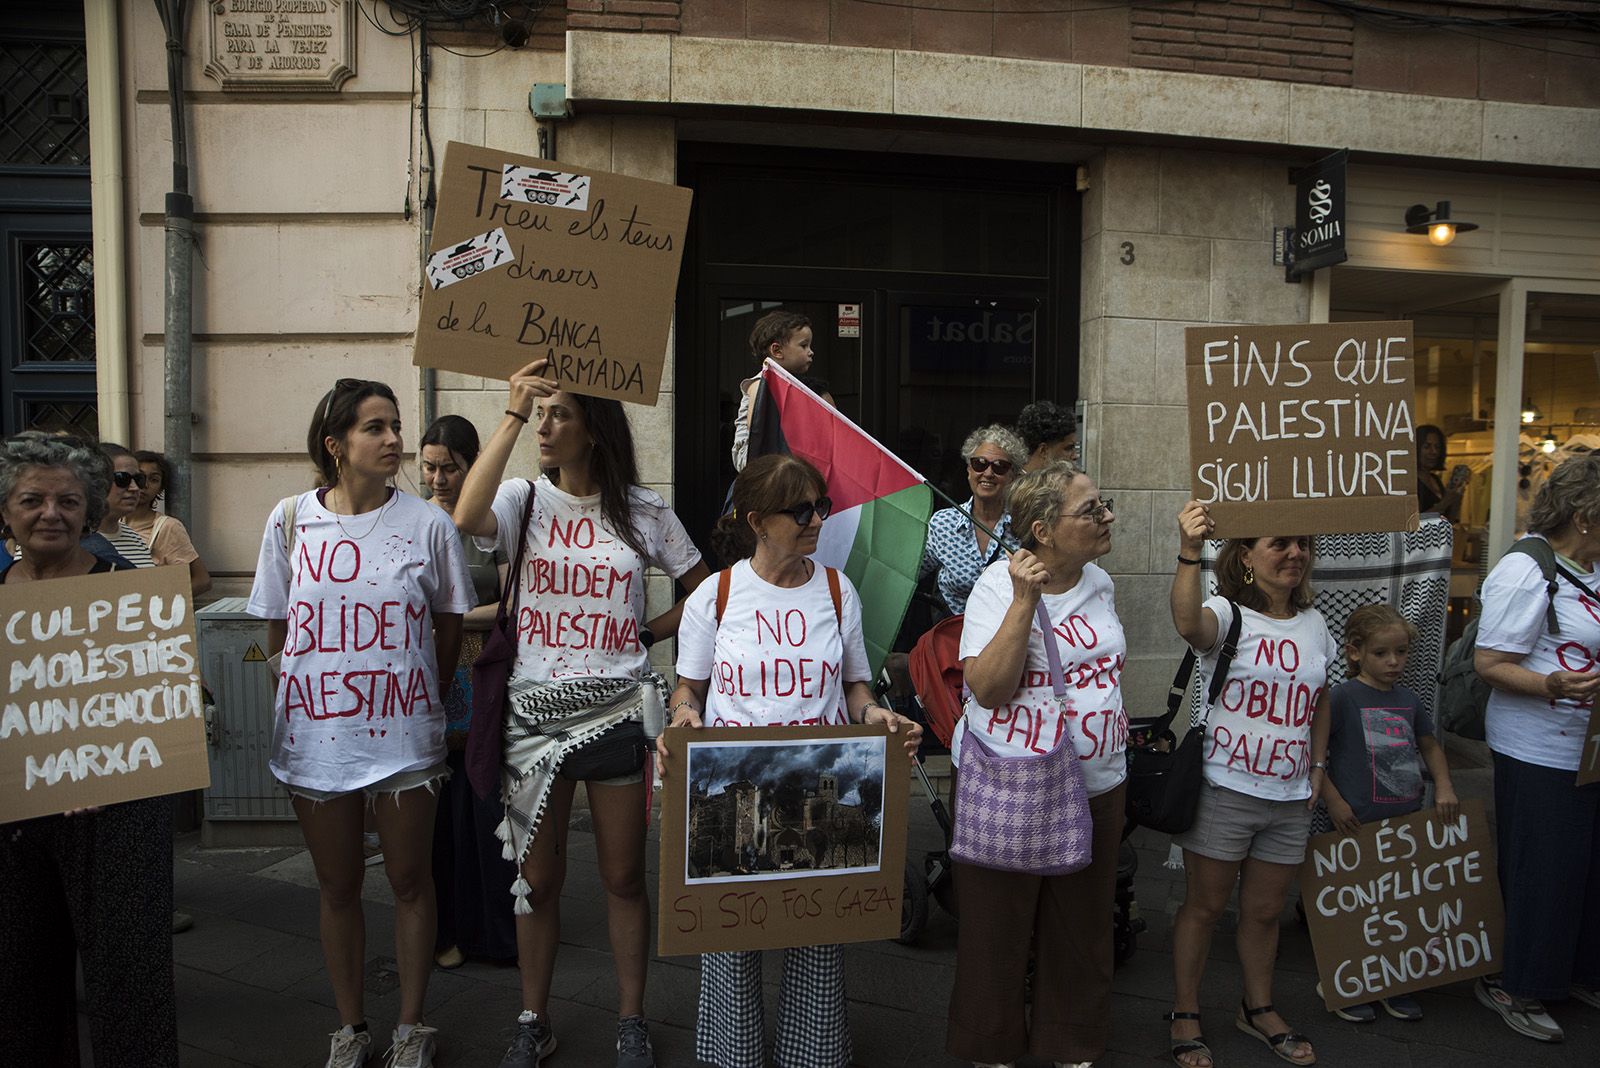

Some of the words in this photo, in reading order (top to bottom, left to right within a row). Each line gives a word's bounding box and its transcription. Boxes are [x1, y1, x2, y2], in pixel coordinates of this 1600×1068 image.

[224, 21, 252, 37] CAJA
[256, 24, 271, 37] DE
[276, 23, 333, 38] PENSIONES
[230, 0, 271, 13] EDIFICIO
[275, 0, 327, 13] PROPIEDAD
[226, 40, 256, 53] PARA
[265, 40, 280, 53] LA
[291, 40, 327, 54] VEJEZ
[233, 56, 241, 69] Y
[248, 56, 263, 70] DE
[269, 56, 320, 70] AHORROS
[467, 164, 552, 232] Treu
[568, 199, 609, 241] els
[620, 205, 673, 251] teus
[507, 245, 599, 290] diners
[1120, 241, 1135, 265] 3
[437, 301, 459, 331] de
[467, 301, 500, 337] la
[516, 302, 602, 355] BANCA
[540, 348, 644, 394] ARMADA
[1204, 335, 1312, 387] FINS
[1334, 337, 1406, 386] QUE
[1207, 393, 1415, 444] PALESTINA
[1197, 455, 1269, 504] SIGUI
[1293, 449, 1409, 498] LLIURE
[548, 516, 595, 549] NO
[298, 540, 361, 586] NO
[526, 557, 633, 604] OBLIDEM
[284, 595, 427, 656] OBLIDEM
[756, 609, 806, 647] NO
[713, 658, 840, 699] OBLIDEM
[1255, 638, 1299, 673] NO
[280, 664, 432, 723] ALESTINA
[25, 736, 163, 791] MARXA
[1313, 838, 1361, 877] NO
[1376, 818, 1418, 863] ÉS
[1426, 814, 1468, 850] UN
[782, 888, 823, 920] FOS
[834, 886, 896, 919] GAZA
[1316, 851, 1483, 917] CONFLICTE
[1363, 906, 1408, 947] ÉS
[1418, 898, 1462, 933] UN
